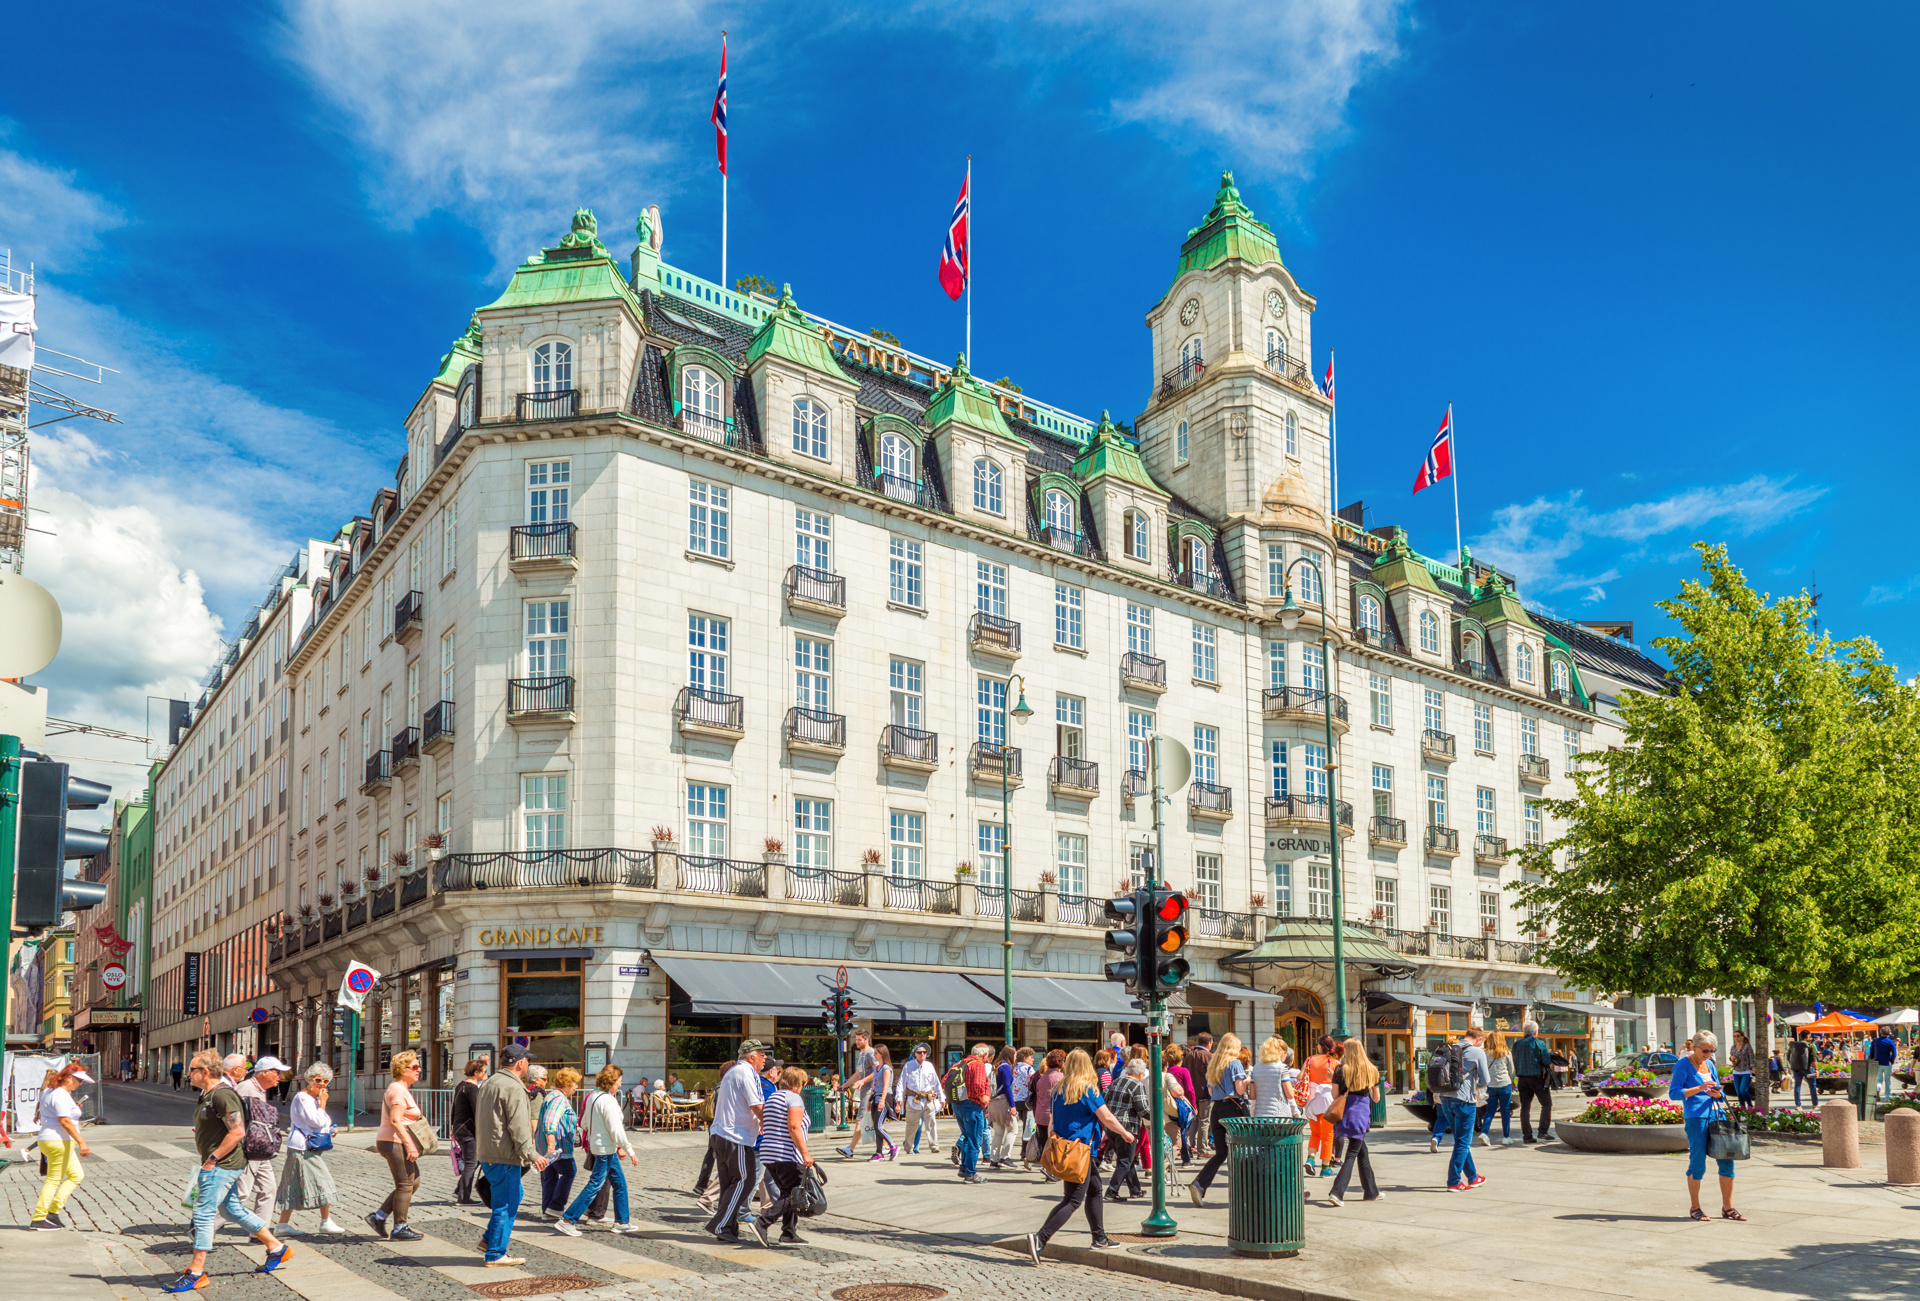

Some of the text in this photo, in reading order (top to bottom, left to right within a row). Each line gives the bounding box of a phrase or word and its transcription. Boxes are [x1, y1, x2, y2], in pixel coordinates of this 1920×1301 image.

[818, 326, 911, 376] RAND
[1277, 838, 1320, 852] GRAND
[478, 926, 604, 946] GRAND CAFE
[1433, 982, 1465, 994] BJERKE
[1493, 986, 1516, 997] FREIA
[1551, 990, 1577, 1001] BJERKE
[1704, 1000, 1716, 1013] DNB
